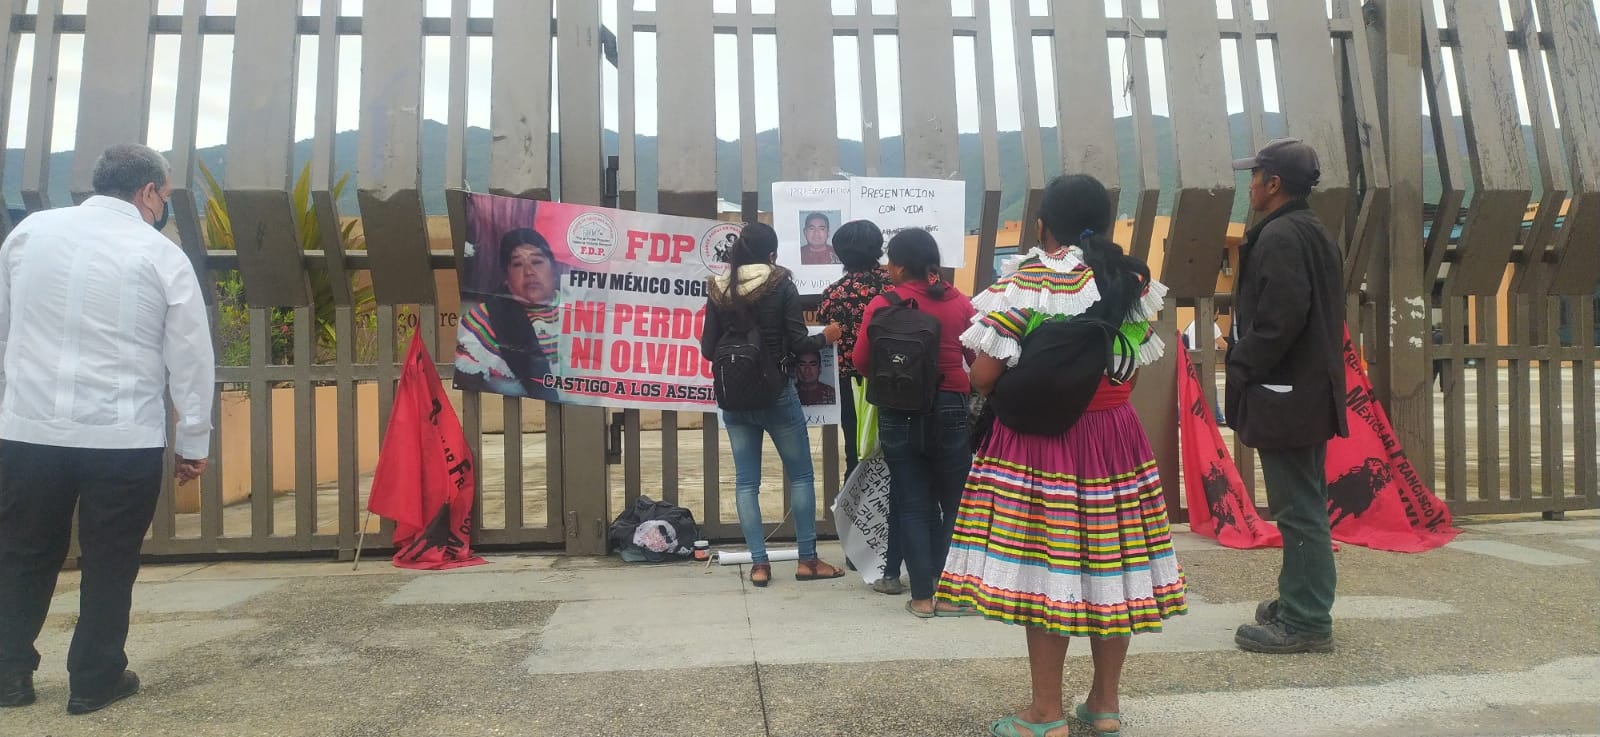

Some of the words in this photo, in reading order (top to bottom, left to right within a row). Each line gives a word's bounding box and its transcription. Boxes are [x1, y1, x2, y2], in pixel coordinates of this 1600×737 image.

[861, 186, 935, 199] PRESENTACION
[879, 205, 896, 214] CON
[903, 204, 924, 214] VIDA
[580, 246, 606, 257] F.D.P.
[625, 230, 696, 264] FDP
[569, 270, 607, 290] FPFV
[609, 271, 671, 295] MÉXICO
[562, 300, 606, 335] ¡NI
[570, 336, 604, 371] NI
[543, 374, 611, 395] CASTIGO
[614, 382, 629, 395] A
[631, 382, 662, 397] LOS
[665, 385, 717, 401] ASESI
